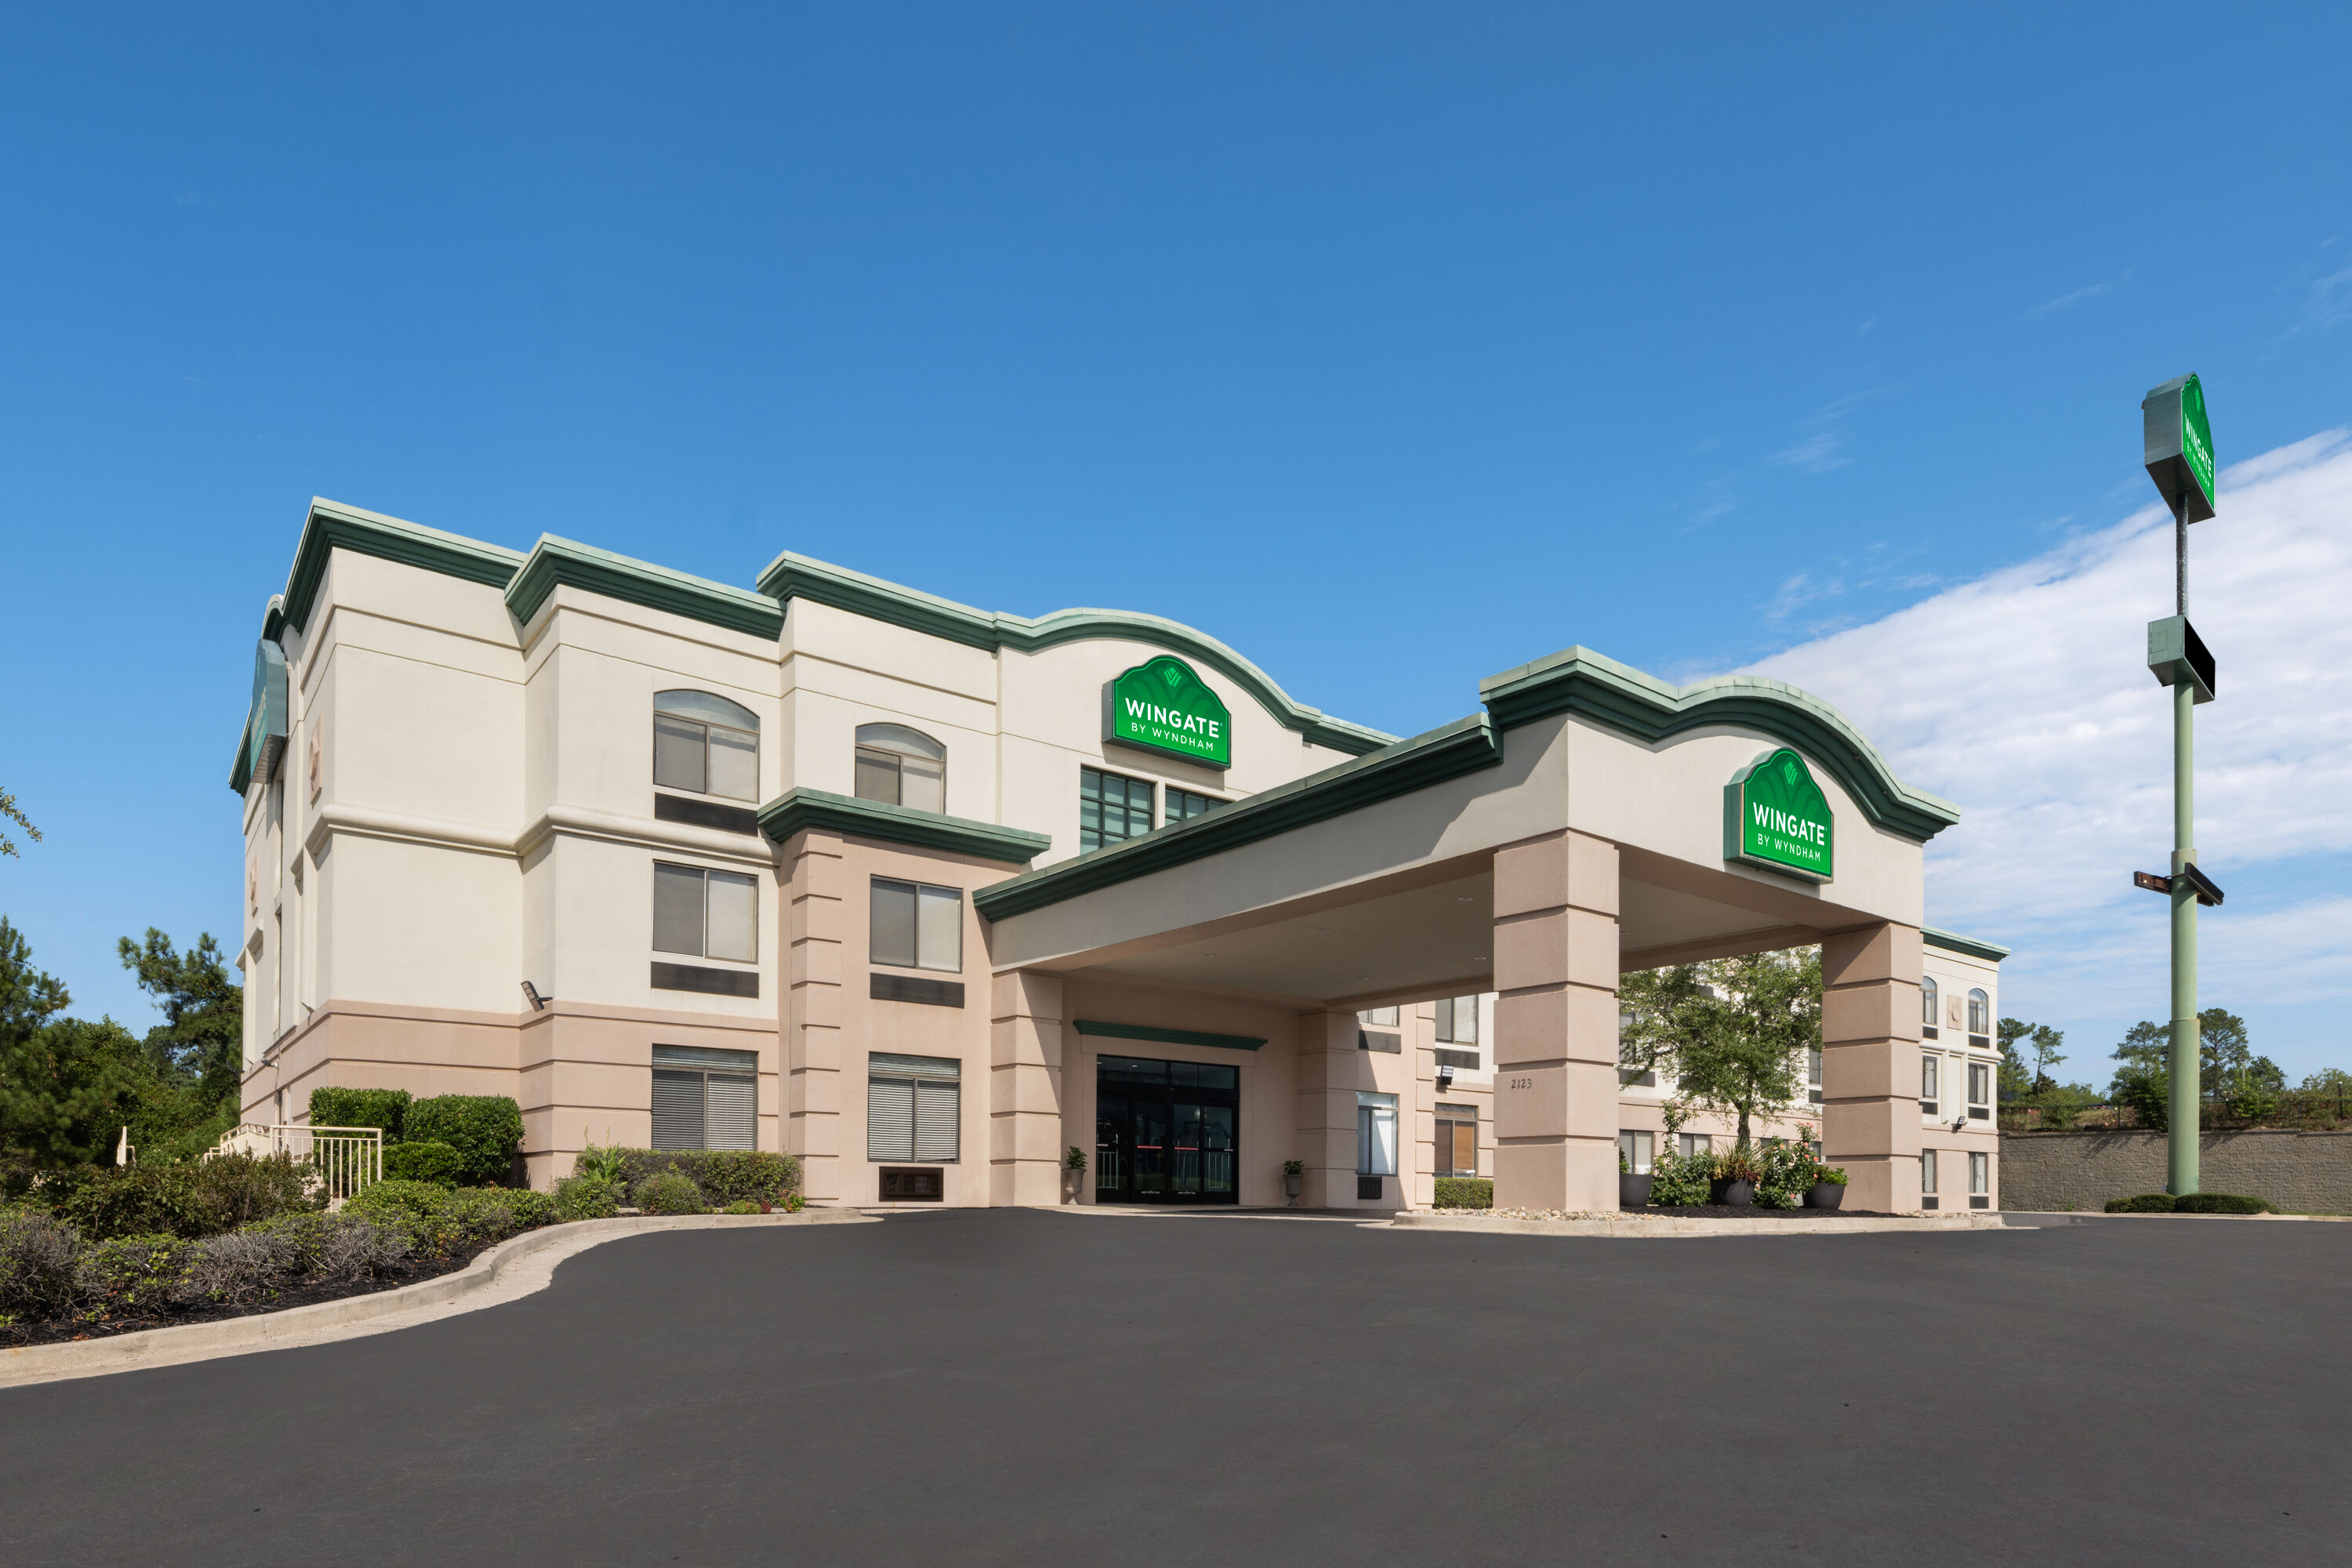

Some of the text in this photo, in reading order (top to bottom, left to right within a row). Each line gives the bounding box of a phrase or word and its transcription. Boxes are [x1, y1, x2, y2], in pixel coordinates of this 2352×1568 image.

[2184, 413, 2212, 478] WINGATE
[1125, 697, 1219, 739] WINGATE
[1131, 722, 1214, 752] BY WYNDHAM
[1752, 801, 1825, 846] WINGATE
[1758, 833, 1820, 862] BY WYNDHAM
[1511, 1078, 1533, 1090] 2123
